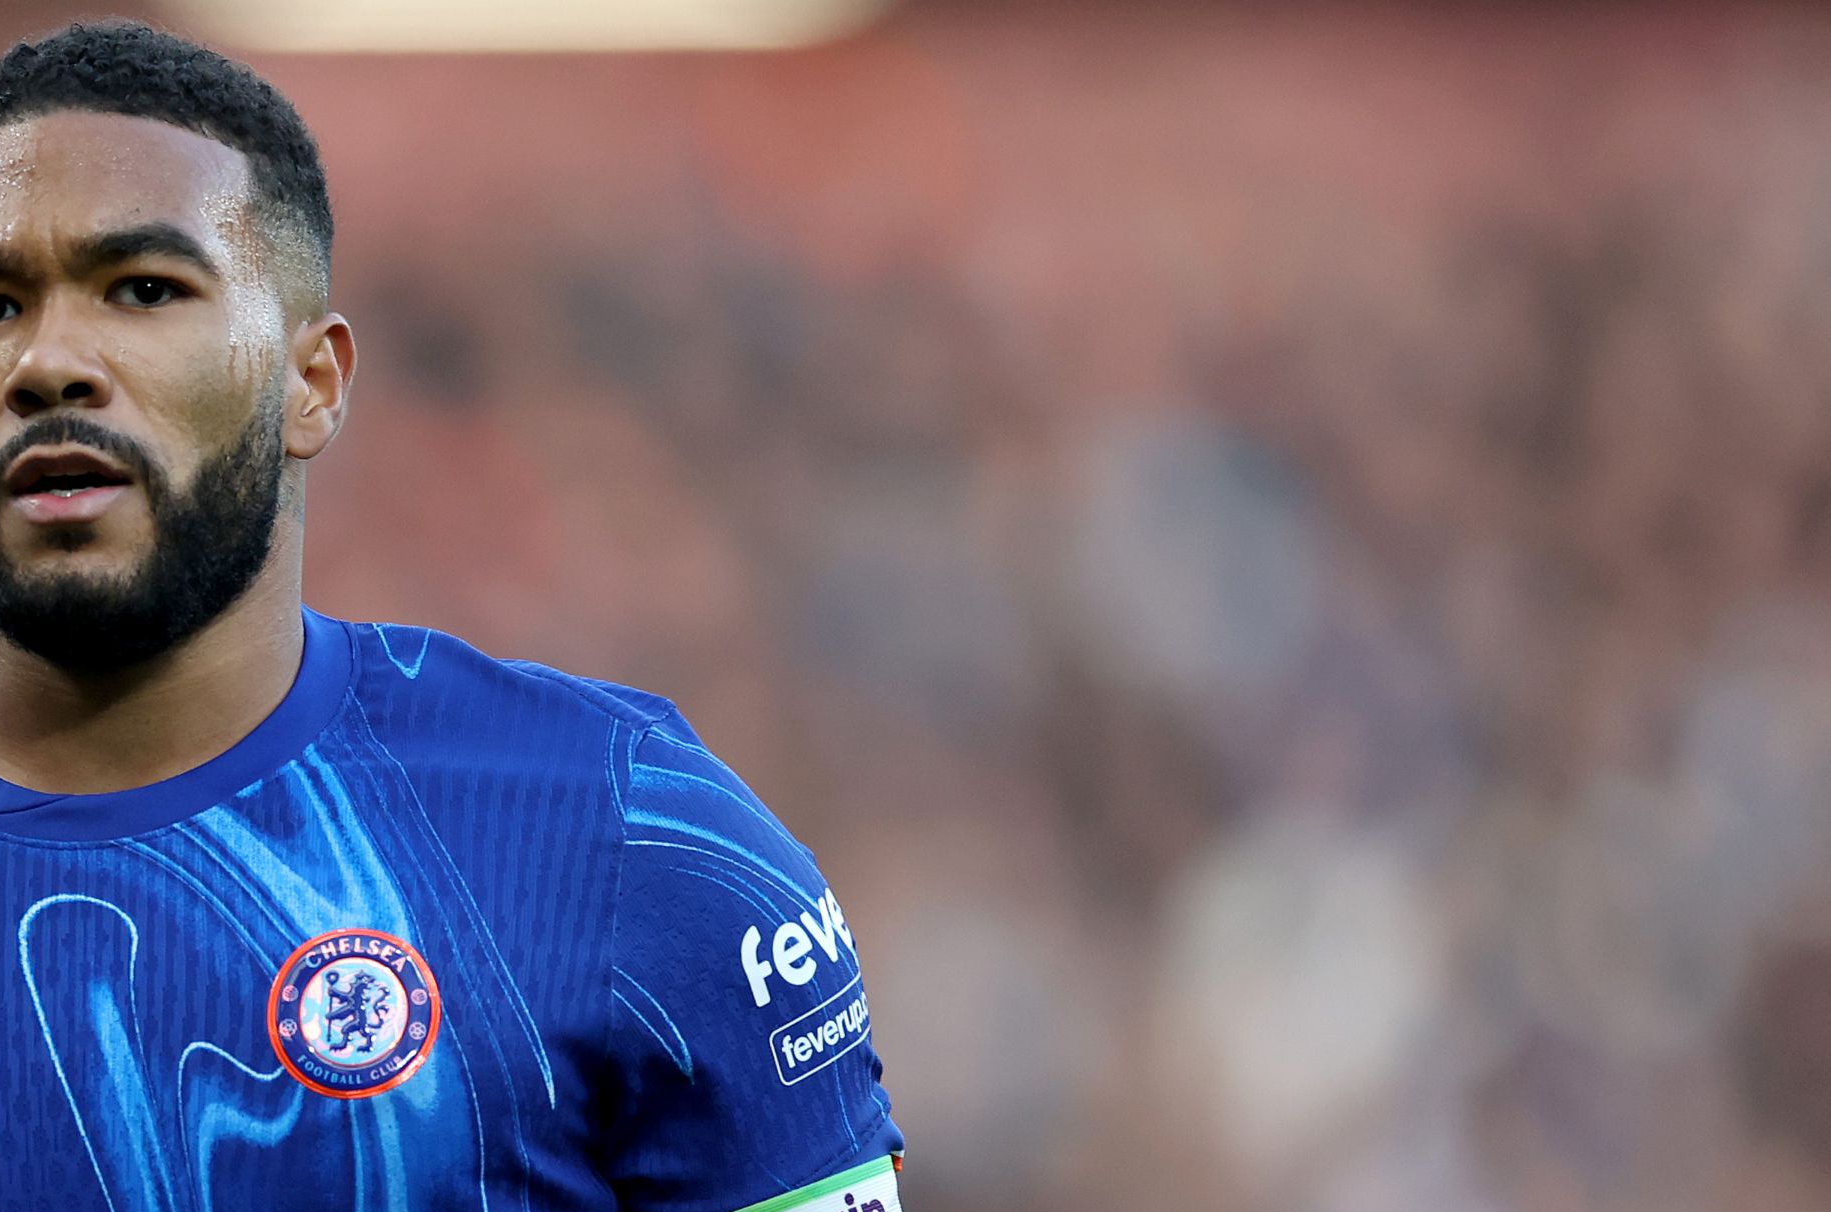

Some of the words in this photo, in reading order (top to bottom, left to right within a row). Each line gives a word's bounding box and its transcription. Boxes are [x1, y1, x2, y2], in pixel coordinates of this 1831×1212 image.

[305, 937, 408, 973] CHELSEA
[297, 1054, 363, 1085] FOOTBALL
[370, 1055, 403, 1081] CLUB
